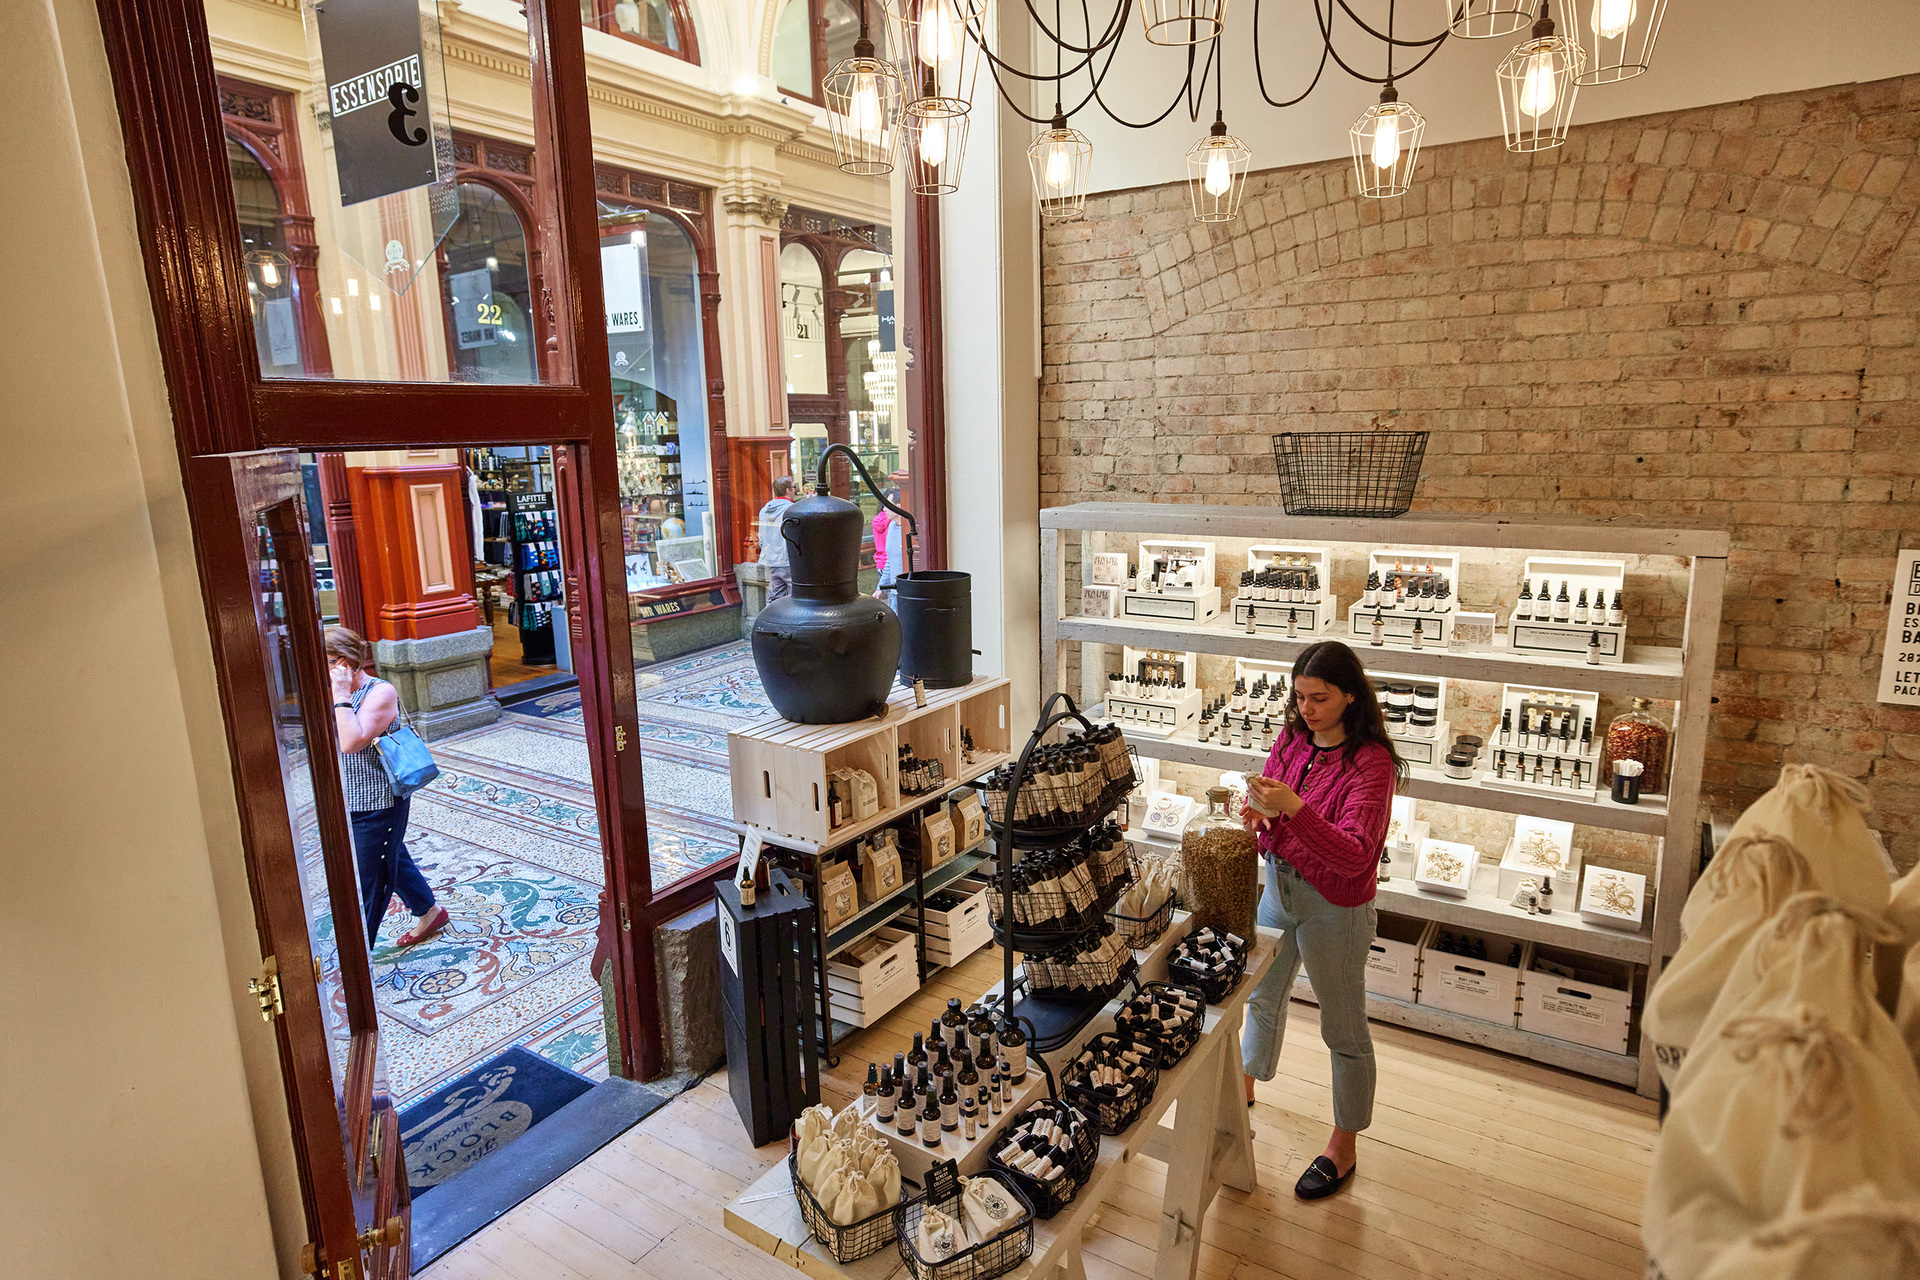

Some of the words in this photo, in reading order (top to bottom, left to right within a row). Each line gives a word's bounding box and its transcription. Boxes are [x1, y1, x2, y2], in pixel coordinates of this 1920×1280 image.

[332, 58, 420, 113] ESSENSORIE
[477, 303, 503, 325] 22
[611, 311, 639, 327] WARES
[797, 323, 810, 340] 21
[516, 494, 547, 503] LAFITTE
[640, 606, 655, 618] MR
[653, 601, 681, 615] WARES
[1906, 602, 1920, 615] B
[411, 1110, 519, 1179] BLOCK
[424, 1116, 478, 1154] Arcade
[461, 1136, 500, 1164] The
